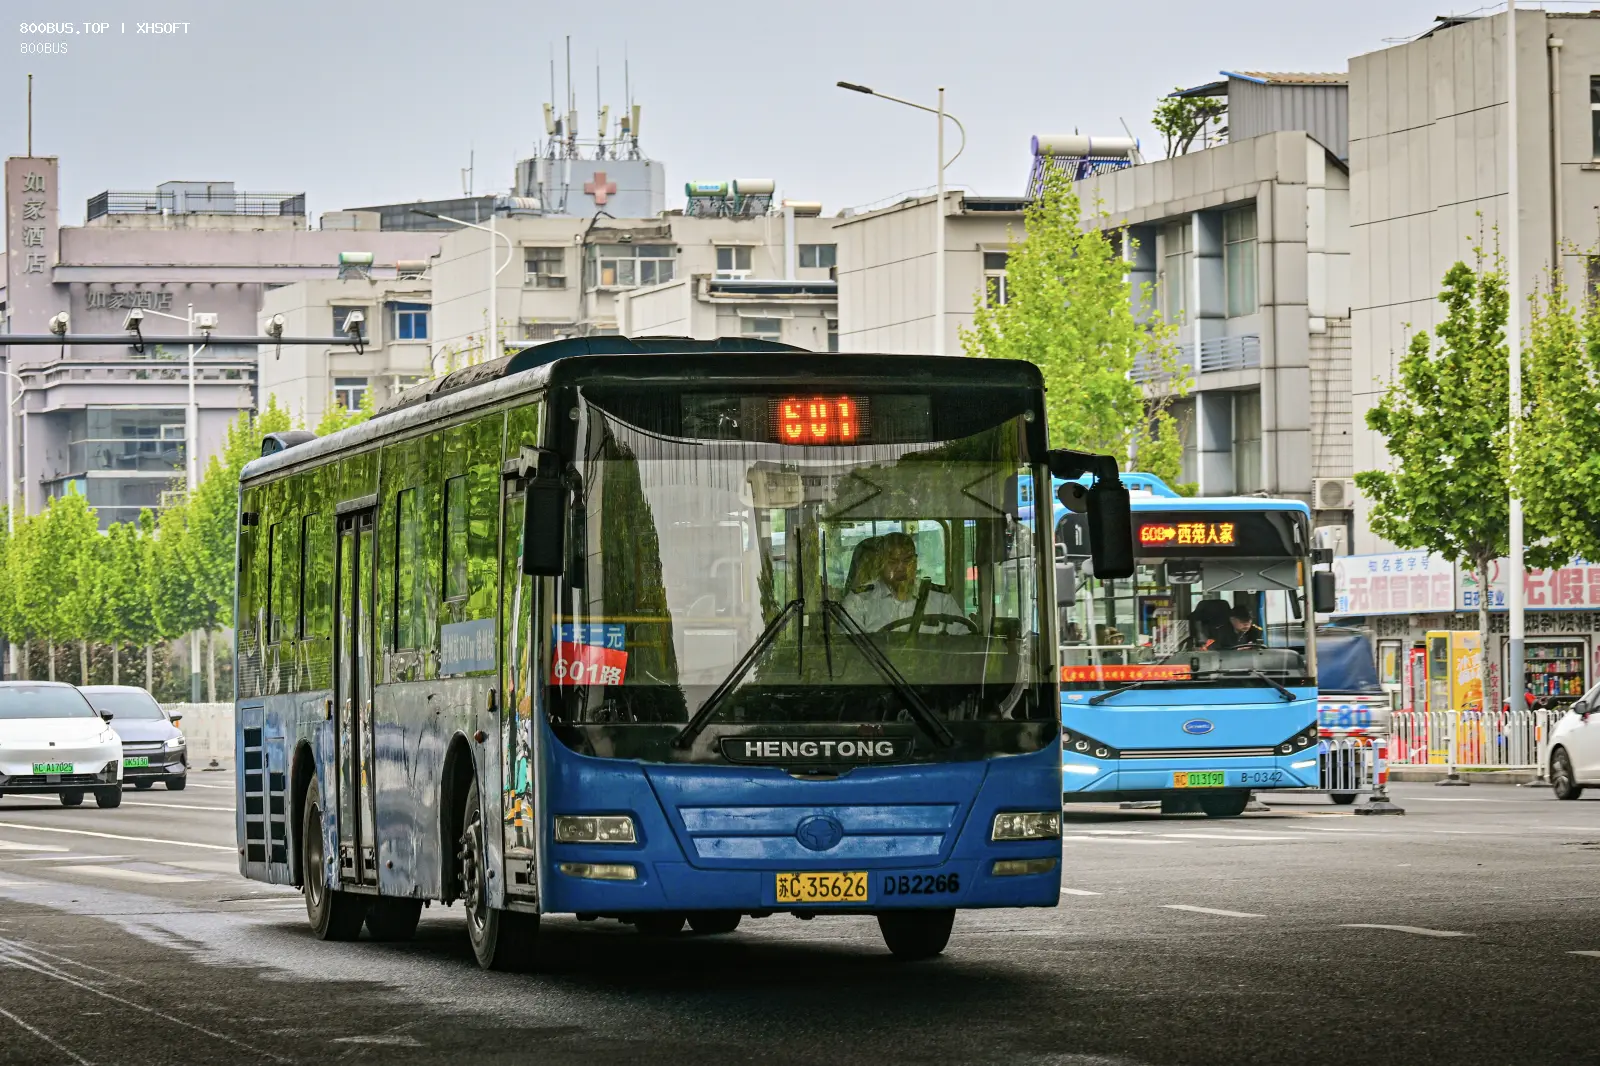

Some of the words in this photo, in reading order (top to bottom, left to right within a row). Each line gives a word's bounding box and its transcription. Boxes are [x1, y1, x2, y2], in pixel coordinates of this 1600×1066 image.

[22, 171, 46, 275] 如家酒店
[86, 291, 173, 311] 如家酒店
[1177, 522, 1234, 545] 西苑人家
[1349, 572, 1451, 611] 无假冒商店
[554, 659, 622, 686] 601路
[745, 741, 894, 757] HENGTONG
[1241, 771, 1283, 783] B-0342
[884, 873, 960, 895] DB2266
